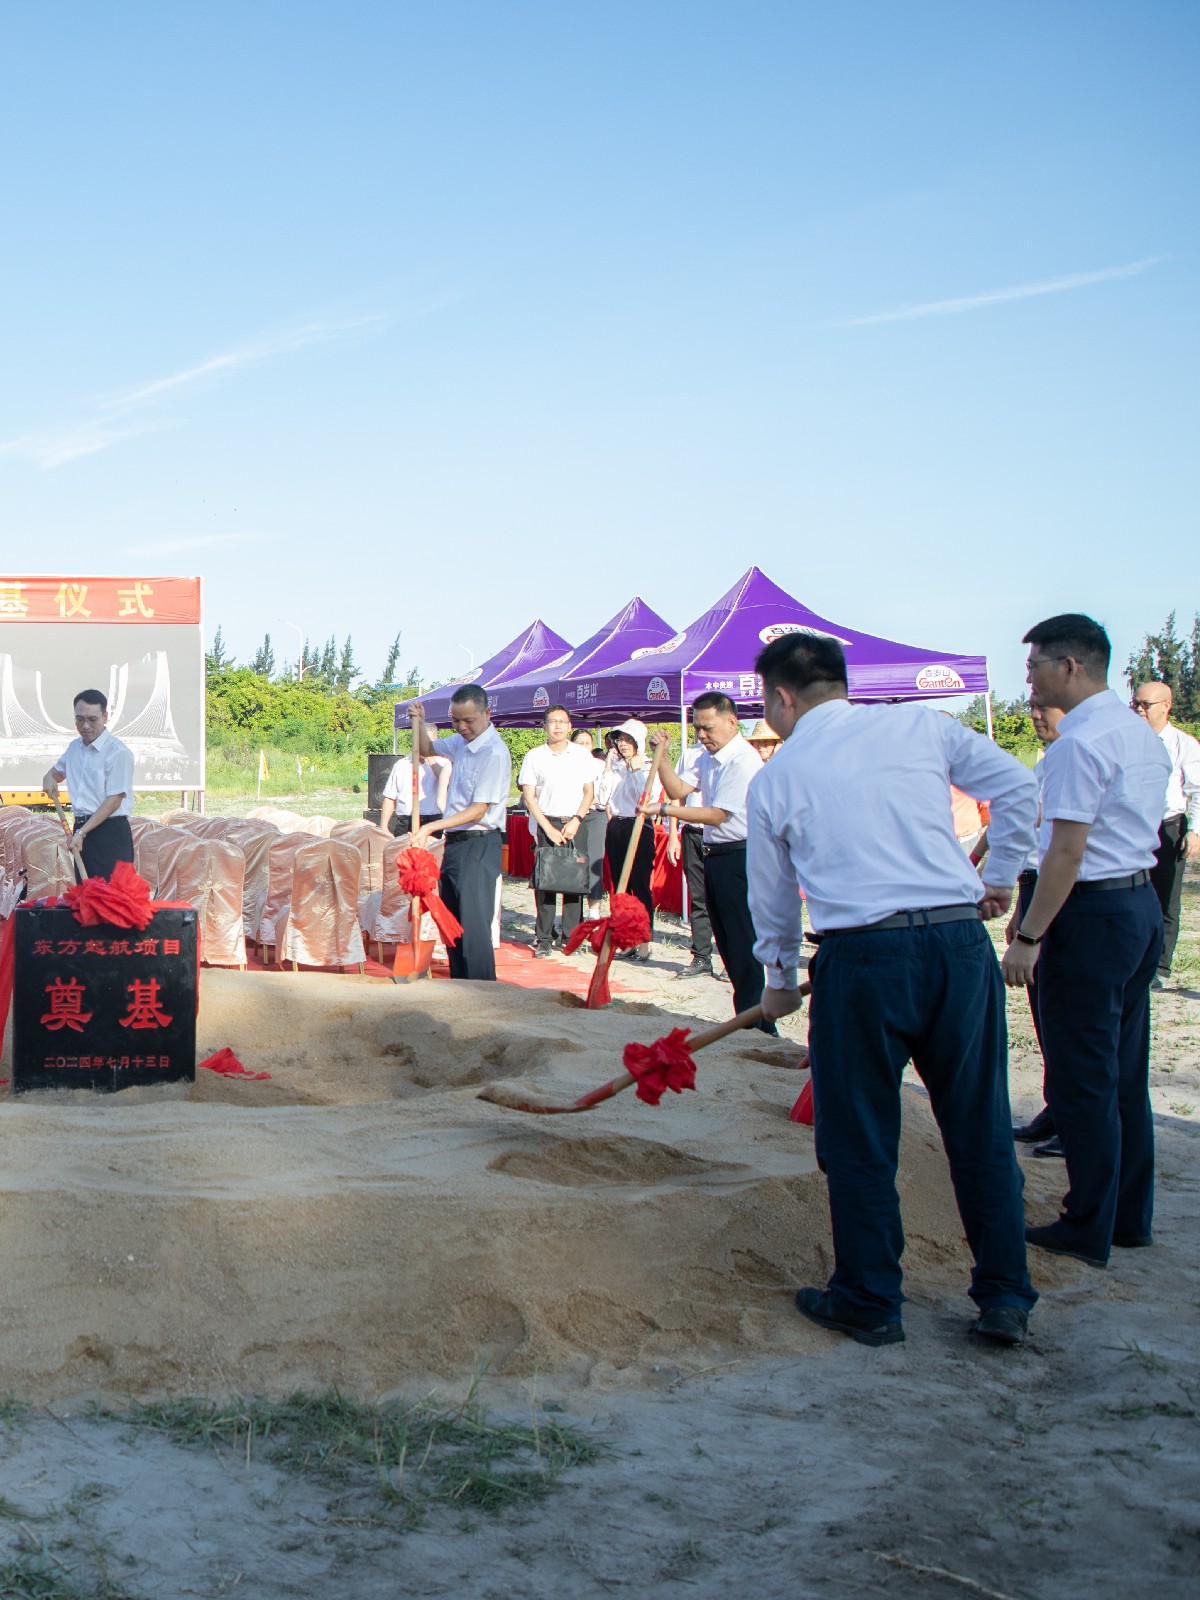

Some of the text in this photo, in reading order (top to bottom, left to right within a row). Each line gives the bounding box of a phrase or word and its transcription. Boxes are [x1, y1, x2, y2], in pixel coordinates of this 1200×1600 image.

[925, 669, 951, 677] 百岁山
[577, 683, 597, 699] 百岁山
[32, 939, 181, 956] 东方起航项目
[39, 976, 174, 1033] 奠基
